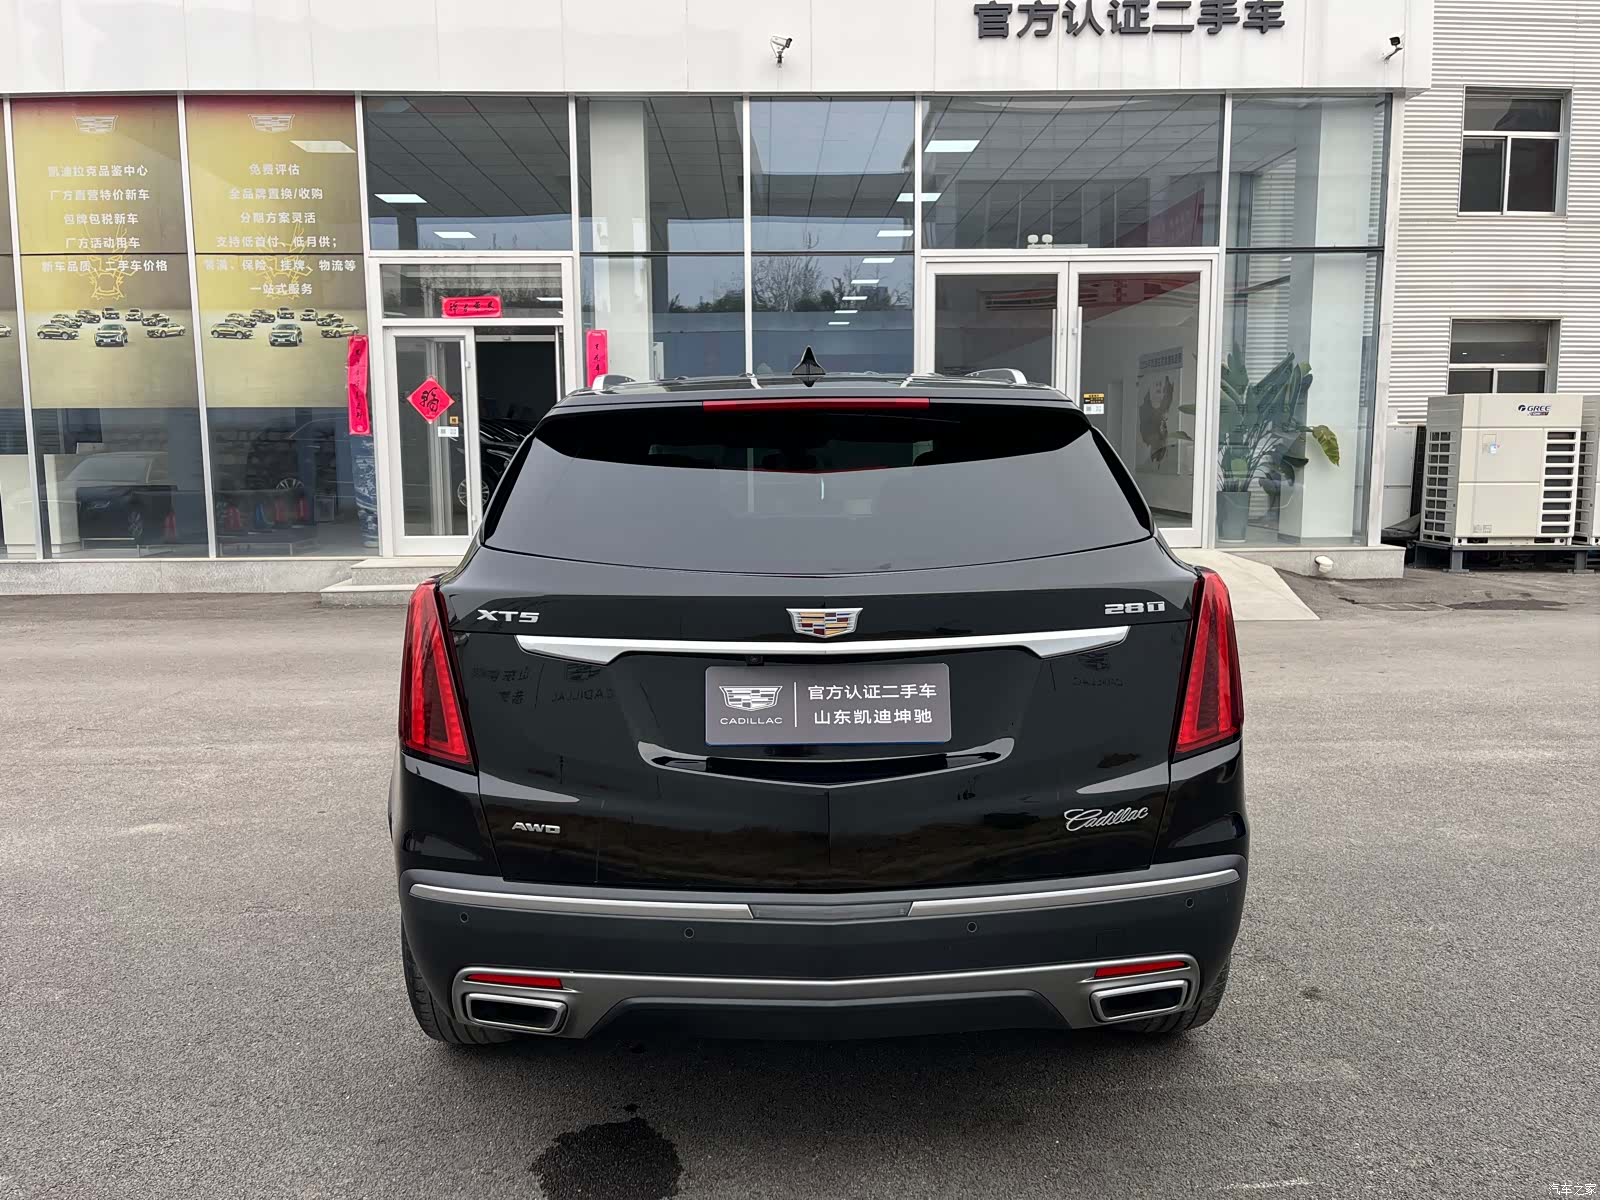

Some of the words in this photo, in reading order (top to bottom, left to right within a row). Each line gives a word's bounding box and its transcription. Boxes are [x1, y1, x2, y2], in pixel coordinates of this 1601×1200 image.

[974, 0, 1286, 38] 官方认证二手车
[249, 163, 300, 176] 免费评估
[49, 188, 150, 201] 厂方直营特价新车
[229, 187, 323, 200] 全品牌置换/收购
[63, 212, 139, 225] 包牌包税新车
[240, 211, 316, 224] 分期方案灵活
[65, 236, 141, 249] 厂方活动用车
[250, 282, 313, 295] 一站式服务
[1104, 601, 1165, 614] 28T
[477, 609, 540, 623] XT5
[808, 683, 937, 701] 官方认证二手车
[719, 716, 783, 725] CADILLAC
[814, 708, 933, 725] 山东凯迪坤驰
[1063, 806, 1149, 832] Cadillac
[511, 821, 561, 834] AWD
